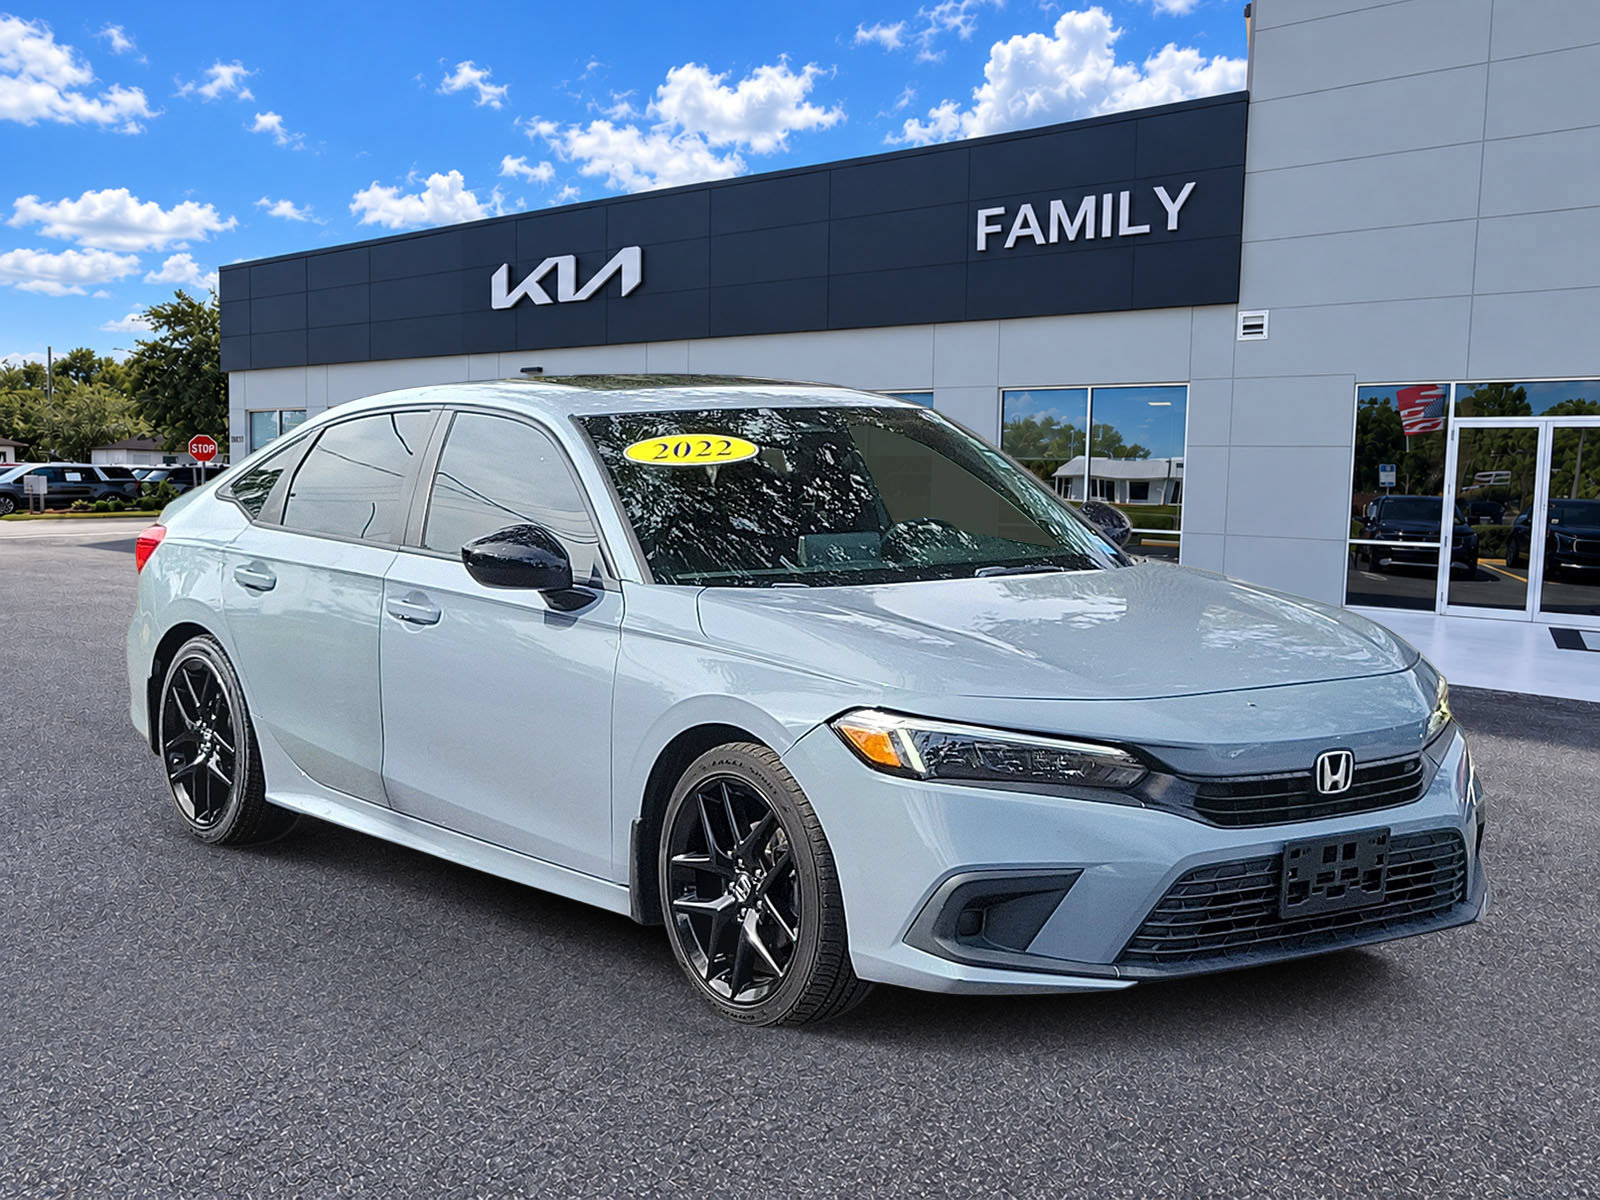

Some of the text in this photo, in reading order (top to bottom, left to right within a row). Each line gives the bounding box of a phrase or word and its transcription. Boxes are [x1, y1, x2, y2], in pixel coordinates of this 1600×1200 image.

[976, 181, 1197, 252] FAMILY
[491, 245, 642, 310] KIA
[191, 443, 215, 454] STOP
[652, 439, 732, 460] 2022
